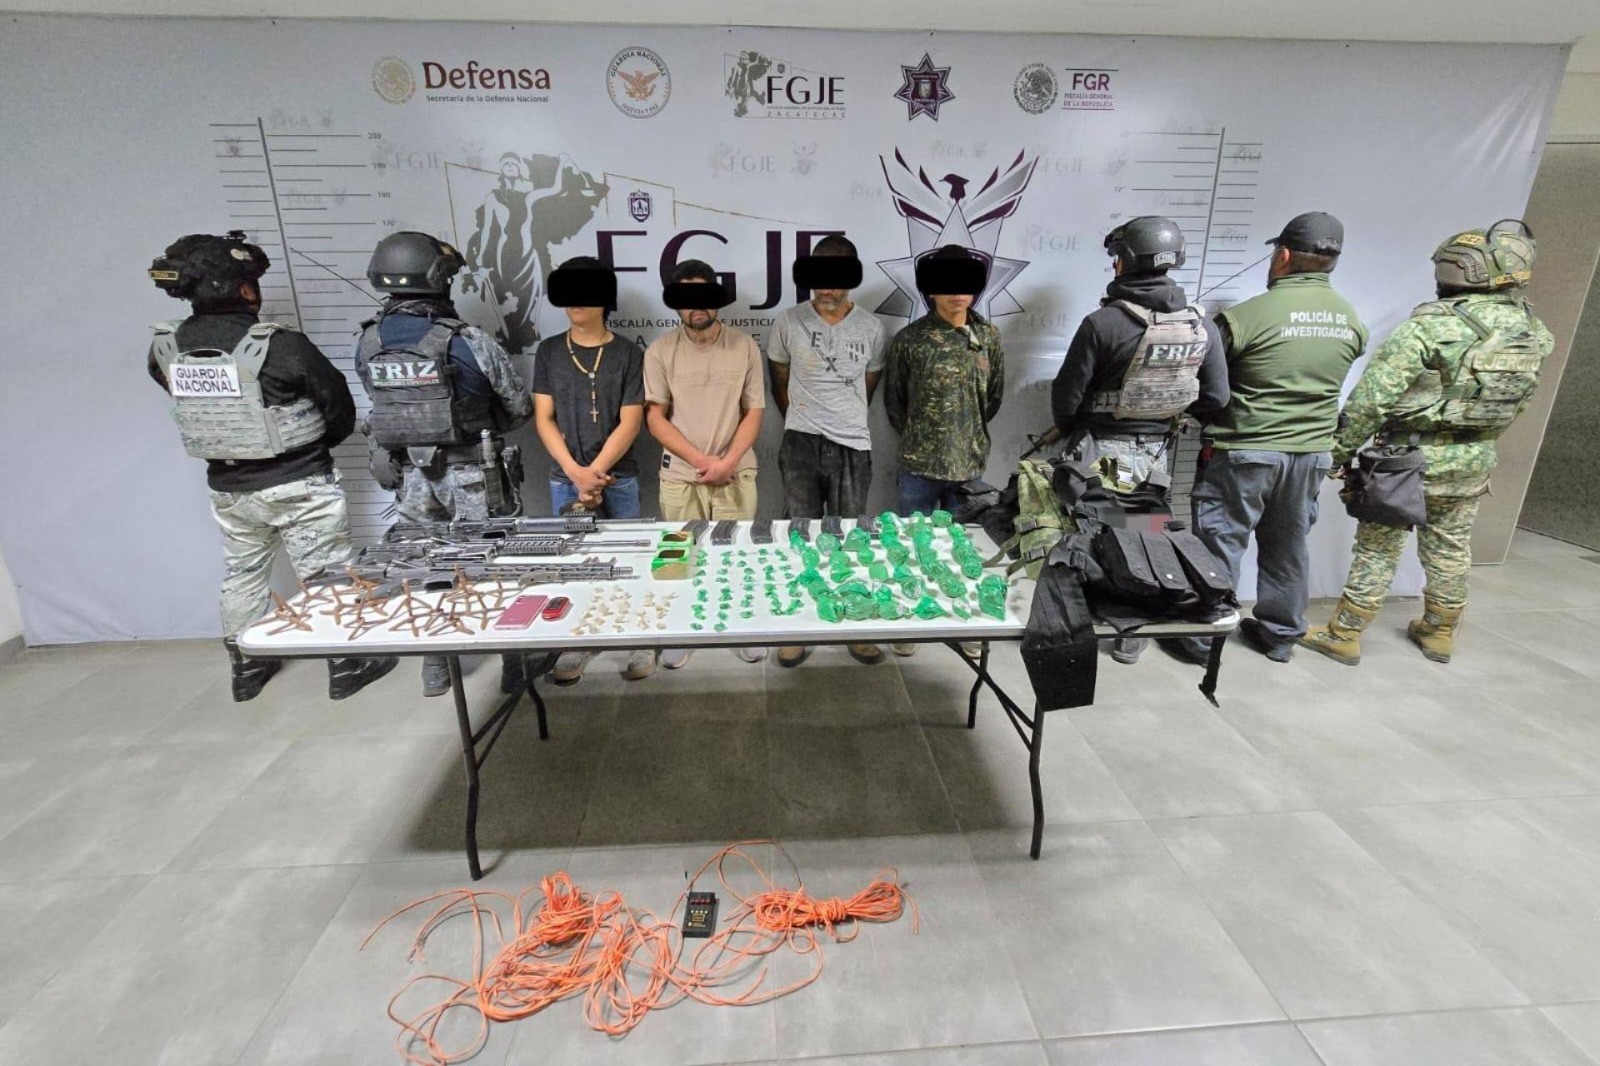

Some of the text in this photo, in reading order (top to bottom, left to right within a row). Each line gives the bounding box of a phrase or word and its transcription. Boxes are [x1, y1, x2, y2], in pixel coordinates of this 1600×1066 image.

[610, 51, 666, 77] GUARDIA NACIONAL
[422, 60, 551, 90] Defensa
[1072, 73, 1111, 91] FGR
[516, 95, 549, 103] Nacional
[766, 76, 845, 105] FGJE
[1290, 310, 1348, 325] POLICÍA DE
[1150, 343, 1206, 360] FRIZ
[176, 367, 229, 379] GUARDIA
[367, 361, 439, 379] FRIZ
[175, 380, 237, 392] NACIONAL
